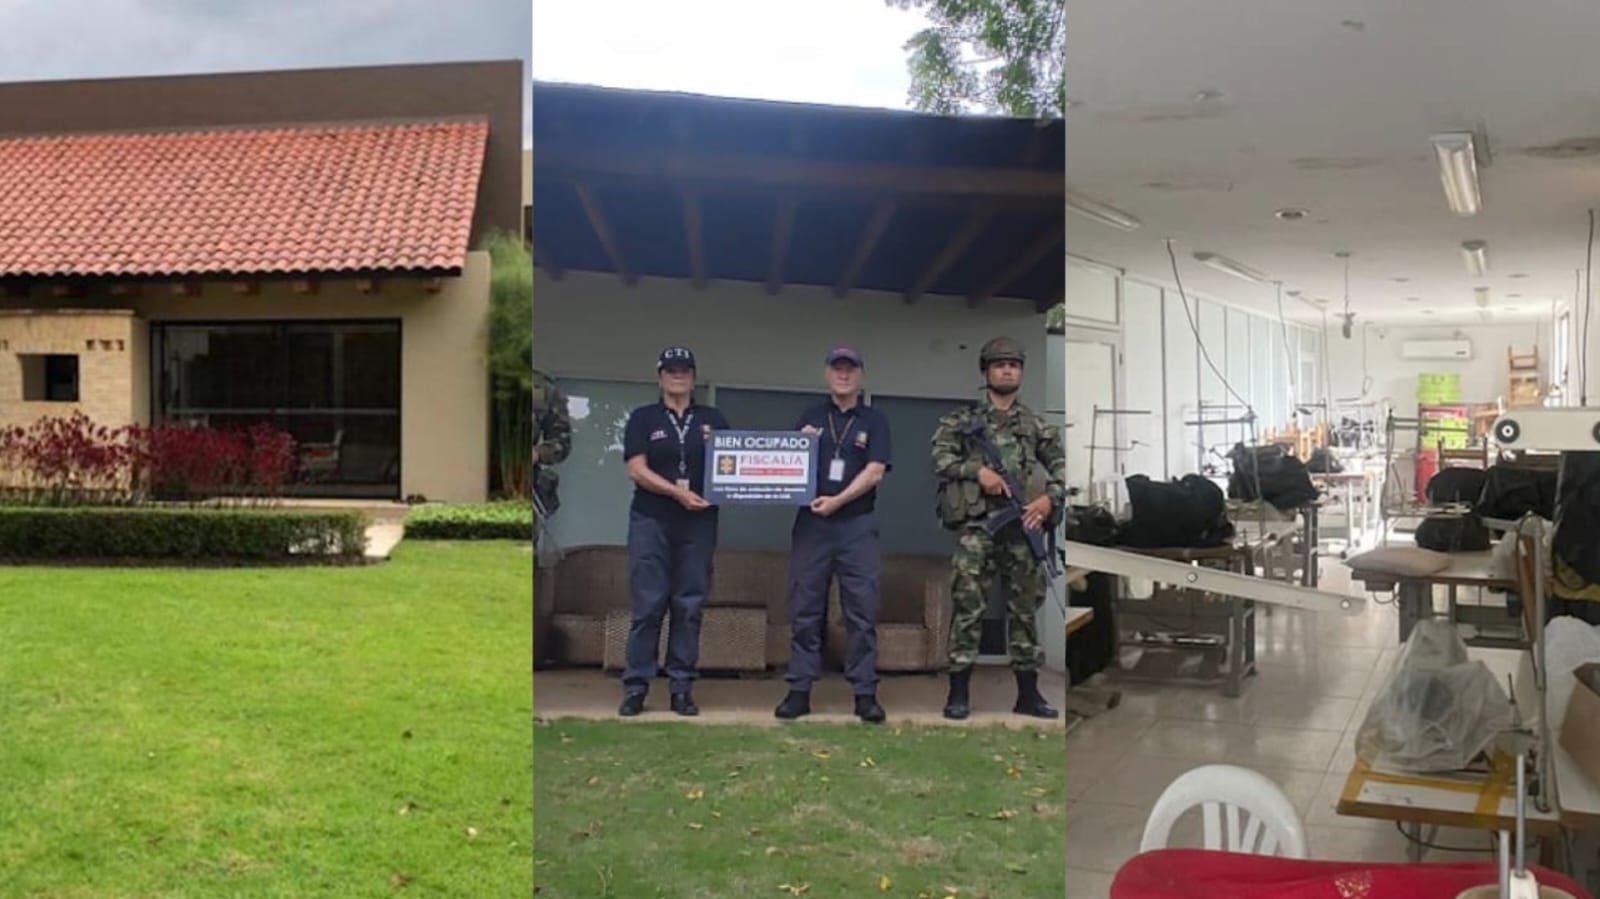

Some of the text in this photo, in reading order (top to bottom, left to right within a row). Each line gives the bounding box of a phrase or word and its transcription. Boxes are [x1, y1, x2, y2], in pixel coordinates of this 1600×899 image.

[664, 348, 689, 359] CTI
[714, 436, 810, 449] BIEN OCUPADO
